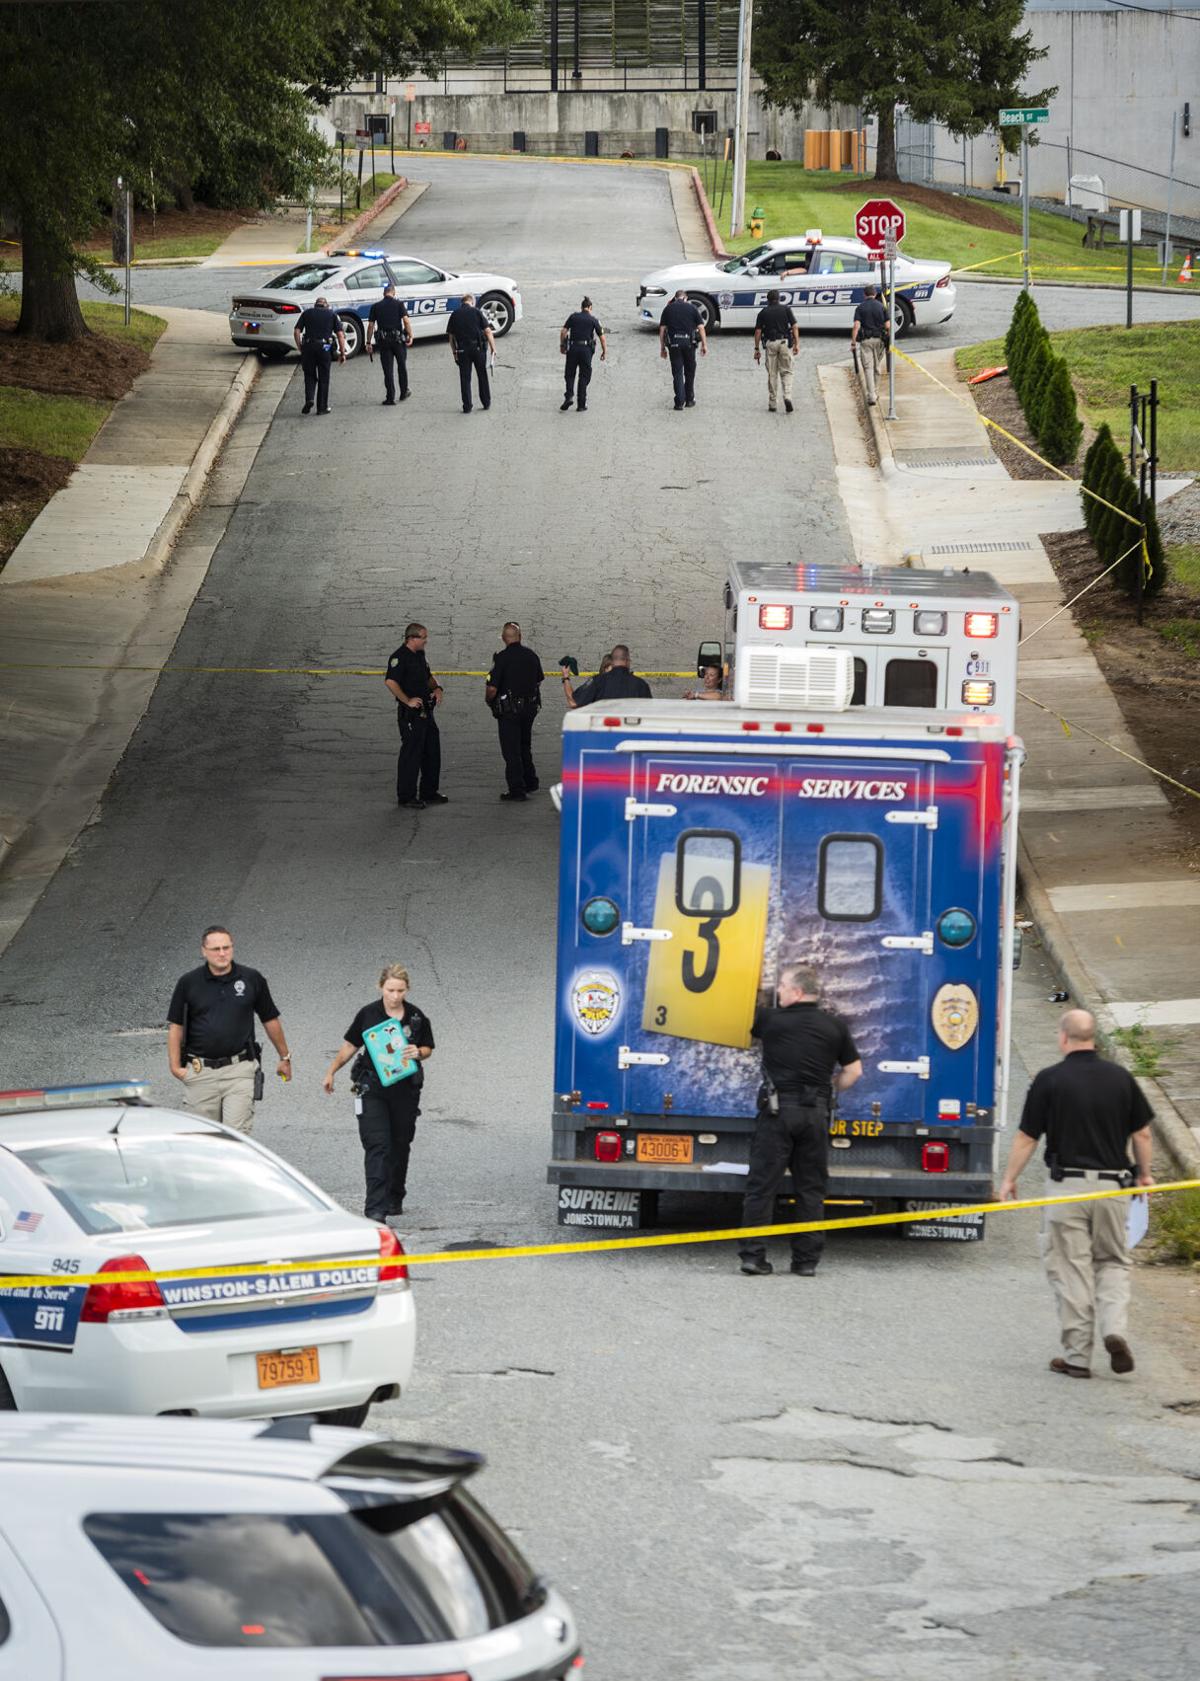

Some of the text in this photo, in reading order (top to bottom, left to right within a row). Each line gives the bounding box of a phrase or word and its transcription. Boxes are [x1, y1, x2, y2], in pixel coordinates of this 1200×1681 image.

[1001, 111, 1025, 123] Beach
[859, 215, 902, 235] STOP
[869, 252, 881, 260] ALL
[404, 298, 448, 315] LICE
[753, 290, 852, 305] POLICE
[656, 773, 908, 801] FORENSIC SERVICES
[681, 875, 725, 994] 3
[655, 1005, 668, 1027] 3
[829, 1120, 884, 1137] UR STEP
[559, 1188, 640, 1212] SUPREME
[51, 1258, 81, 1274] 945
[164, 1274, 315, 1304] WINSTON-SALEM
[319, 1267, 379, 1286] POLICE
[34, 1311, 64, 1331] 911
